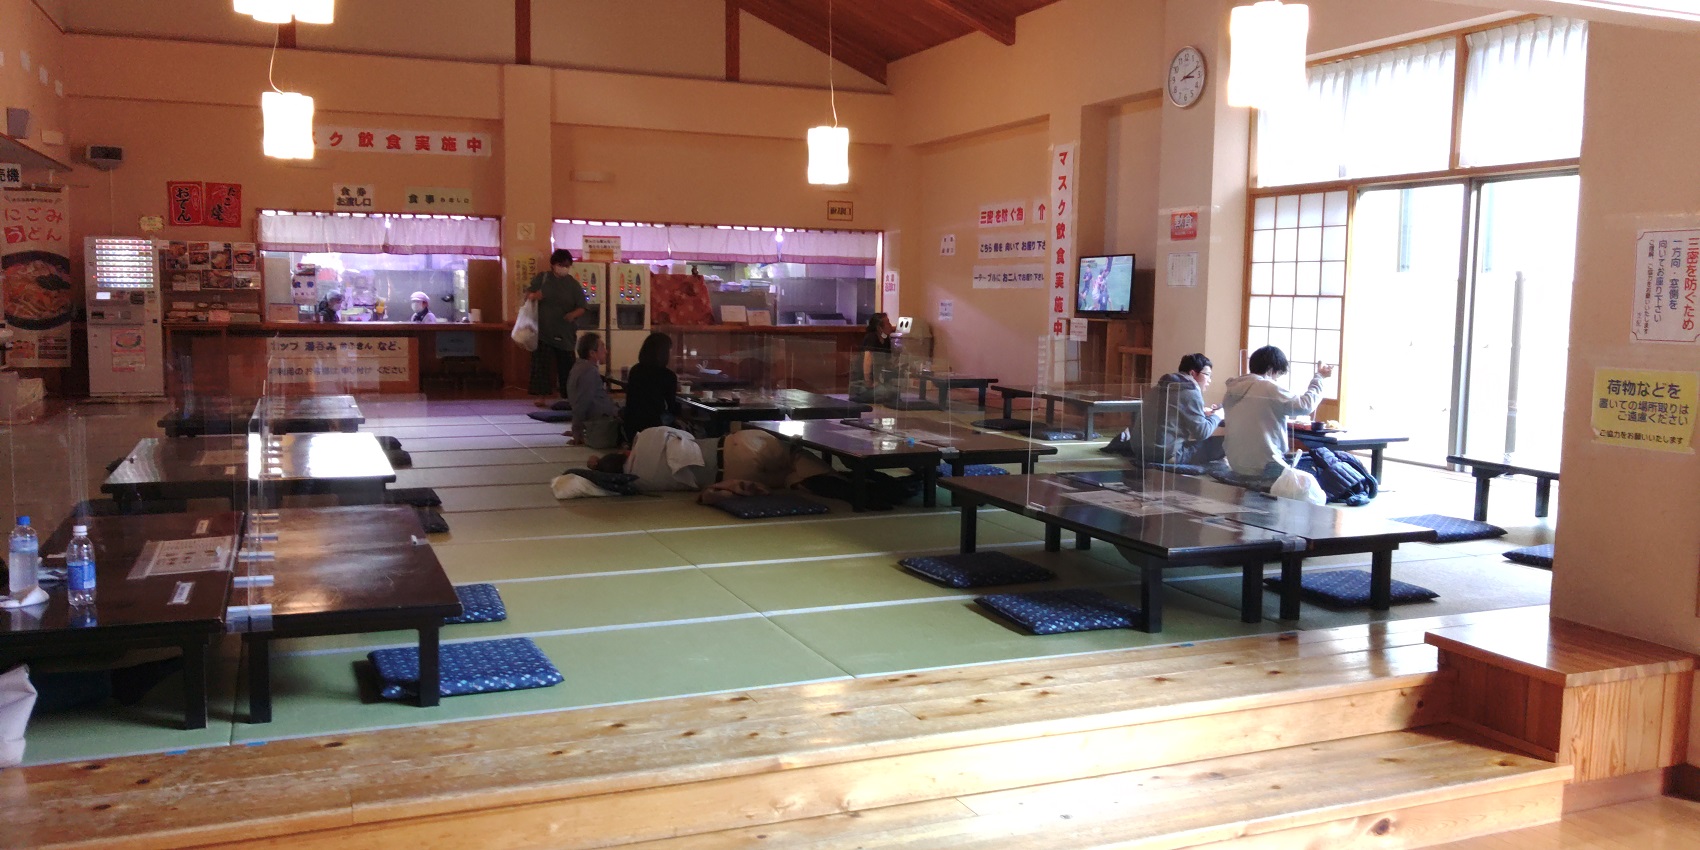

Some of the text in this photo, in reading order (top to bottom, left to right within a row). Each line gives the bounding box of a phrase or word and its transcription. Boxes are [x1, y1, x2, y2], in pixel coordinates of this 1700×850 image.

[312, 130, 482, 154] ク飲食実施中
[1053, 151, 1069, 337] マスク飲食実施中
[1683, 237, 1700, 331] 三密を防ぐため
[1607, 379, 1682, 399] 荷物などを
[1599, 398, 1690, 415] 置いての場所取りは
[1617, 410, 1689, 426] ご遠慮ください
[1599, 429, 1685, 444] ご協力をお願いいたします
